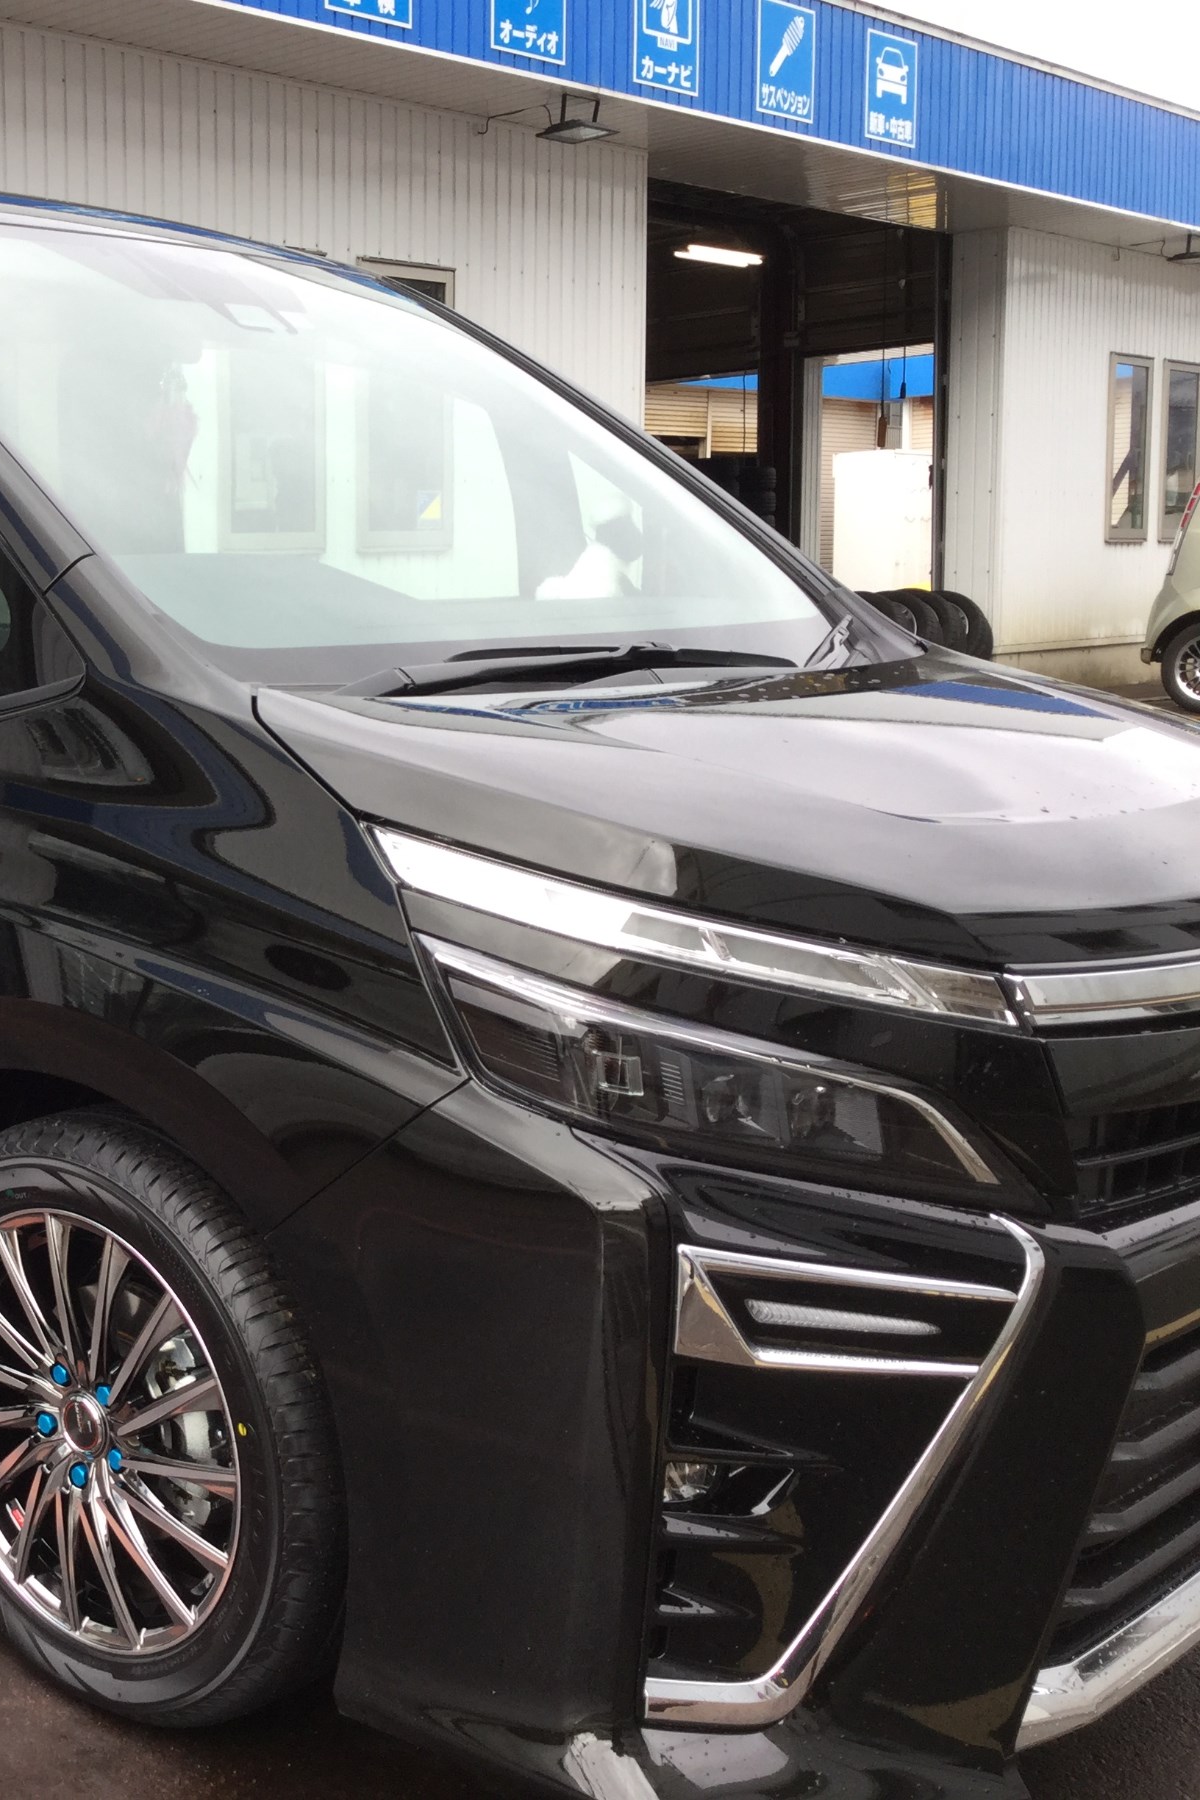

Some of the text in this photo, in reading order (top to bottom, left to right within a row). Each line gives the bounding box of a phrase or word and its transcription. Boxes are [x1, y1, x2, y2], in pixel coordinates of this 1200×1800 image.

[499, 19, 559, 55] オーディオ
[641, 55, 693, 88] カーナビ
[761, 83, 810, 116] サスペンション
